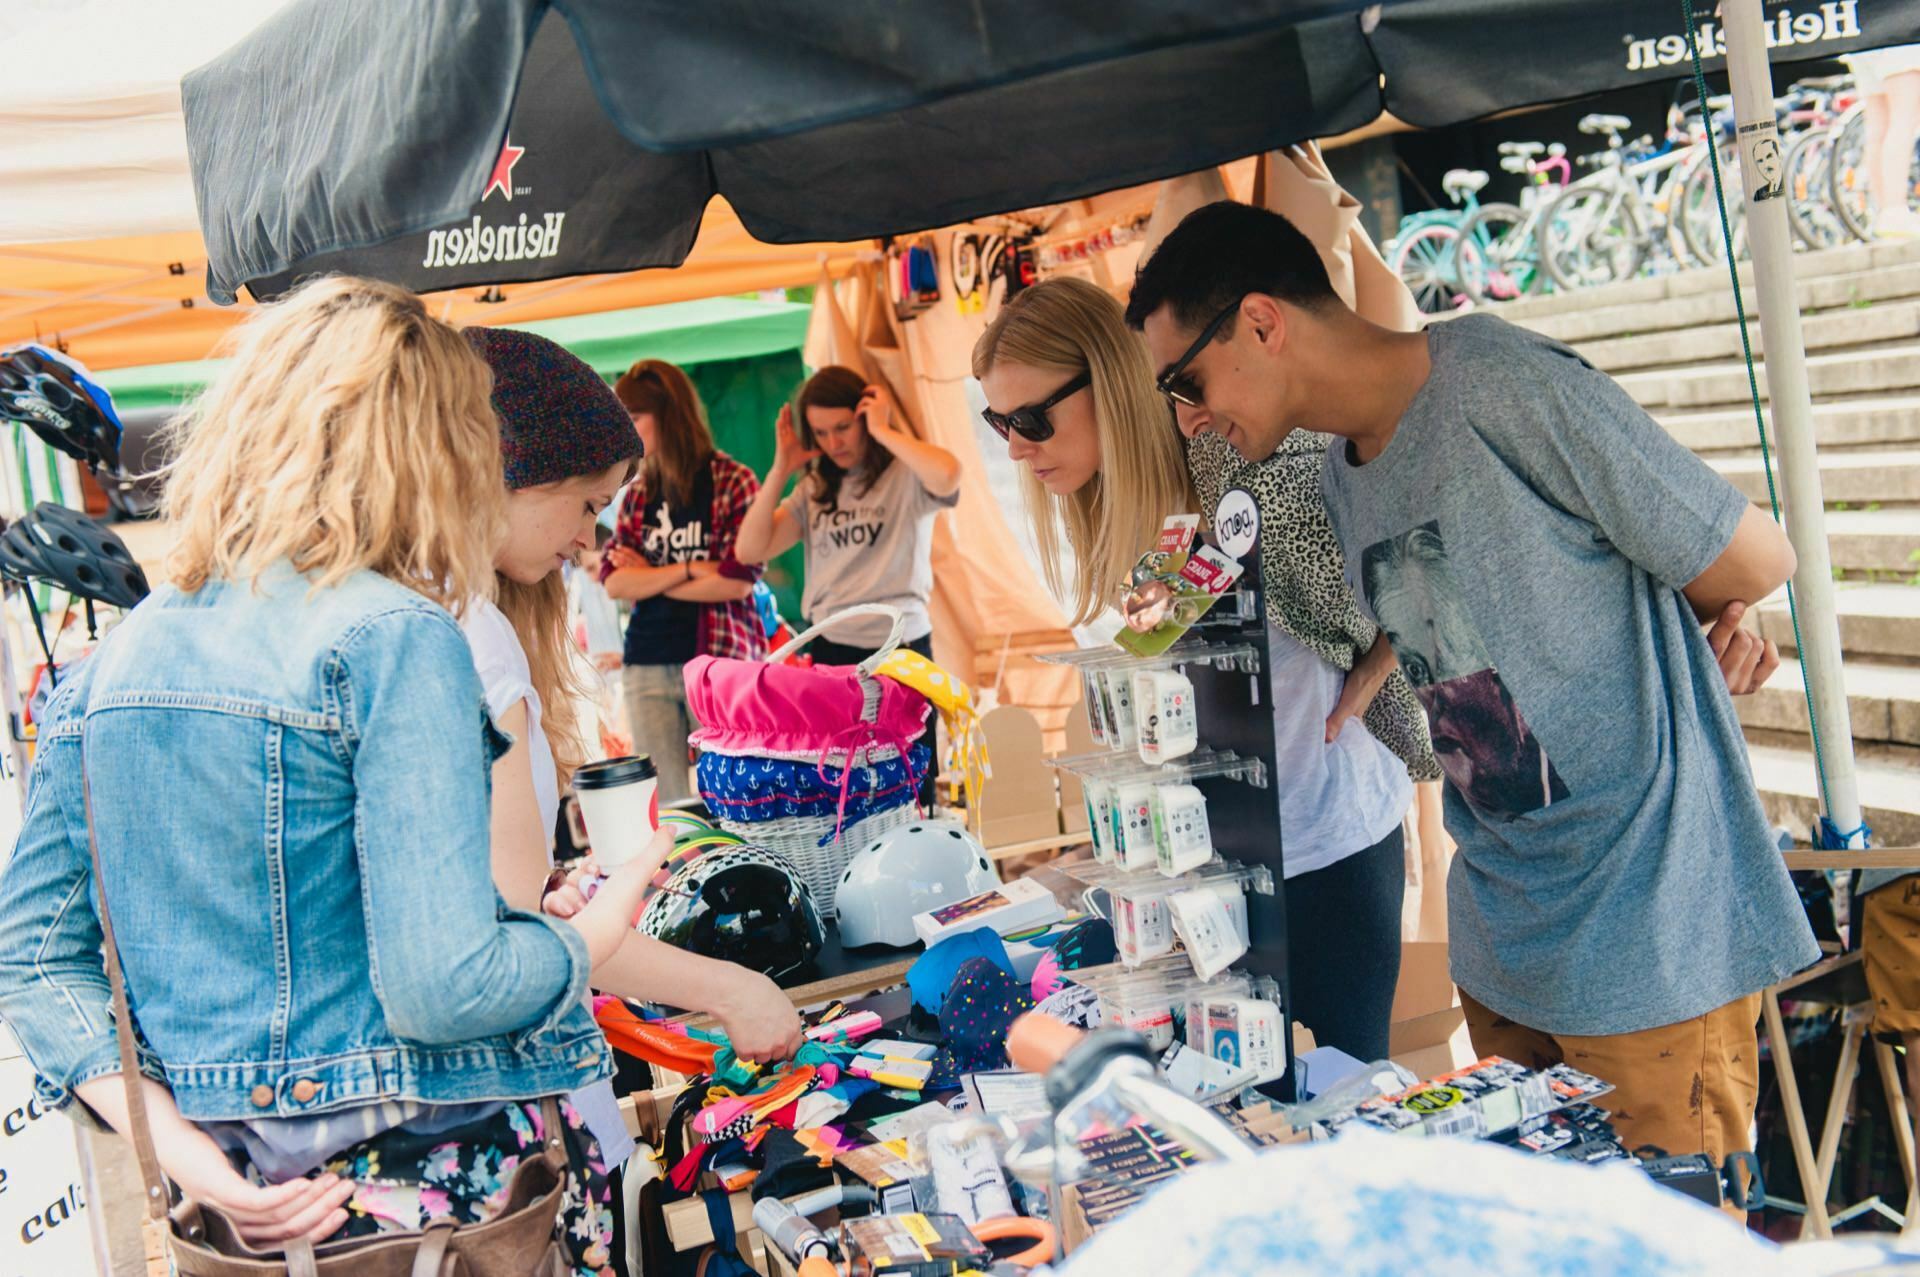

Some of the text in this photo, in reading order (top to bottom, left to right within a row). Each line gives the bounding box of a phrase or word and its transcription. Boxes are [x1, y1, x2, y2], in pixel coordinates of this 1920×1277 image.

[670, 521, 702, 549] all
[829, 522, 884, 550] way
[1186, 560, 1213, 580] CRANE
